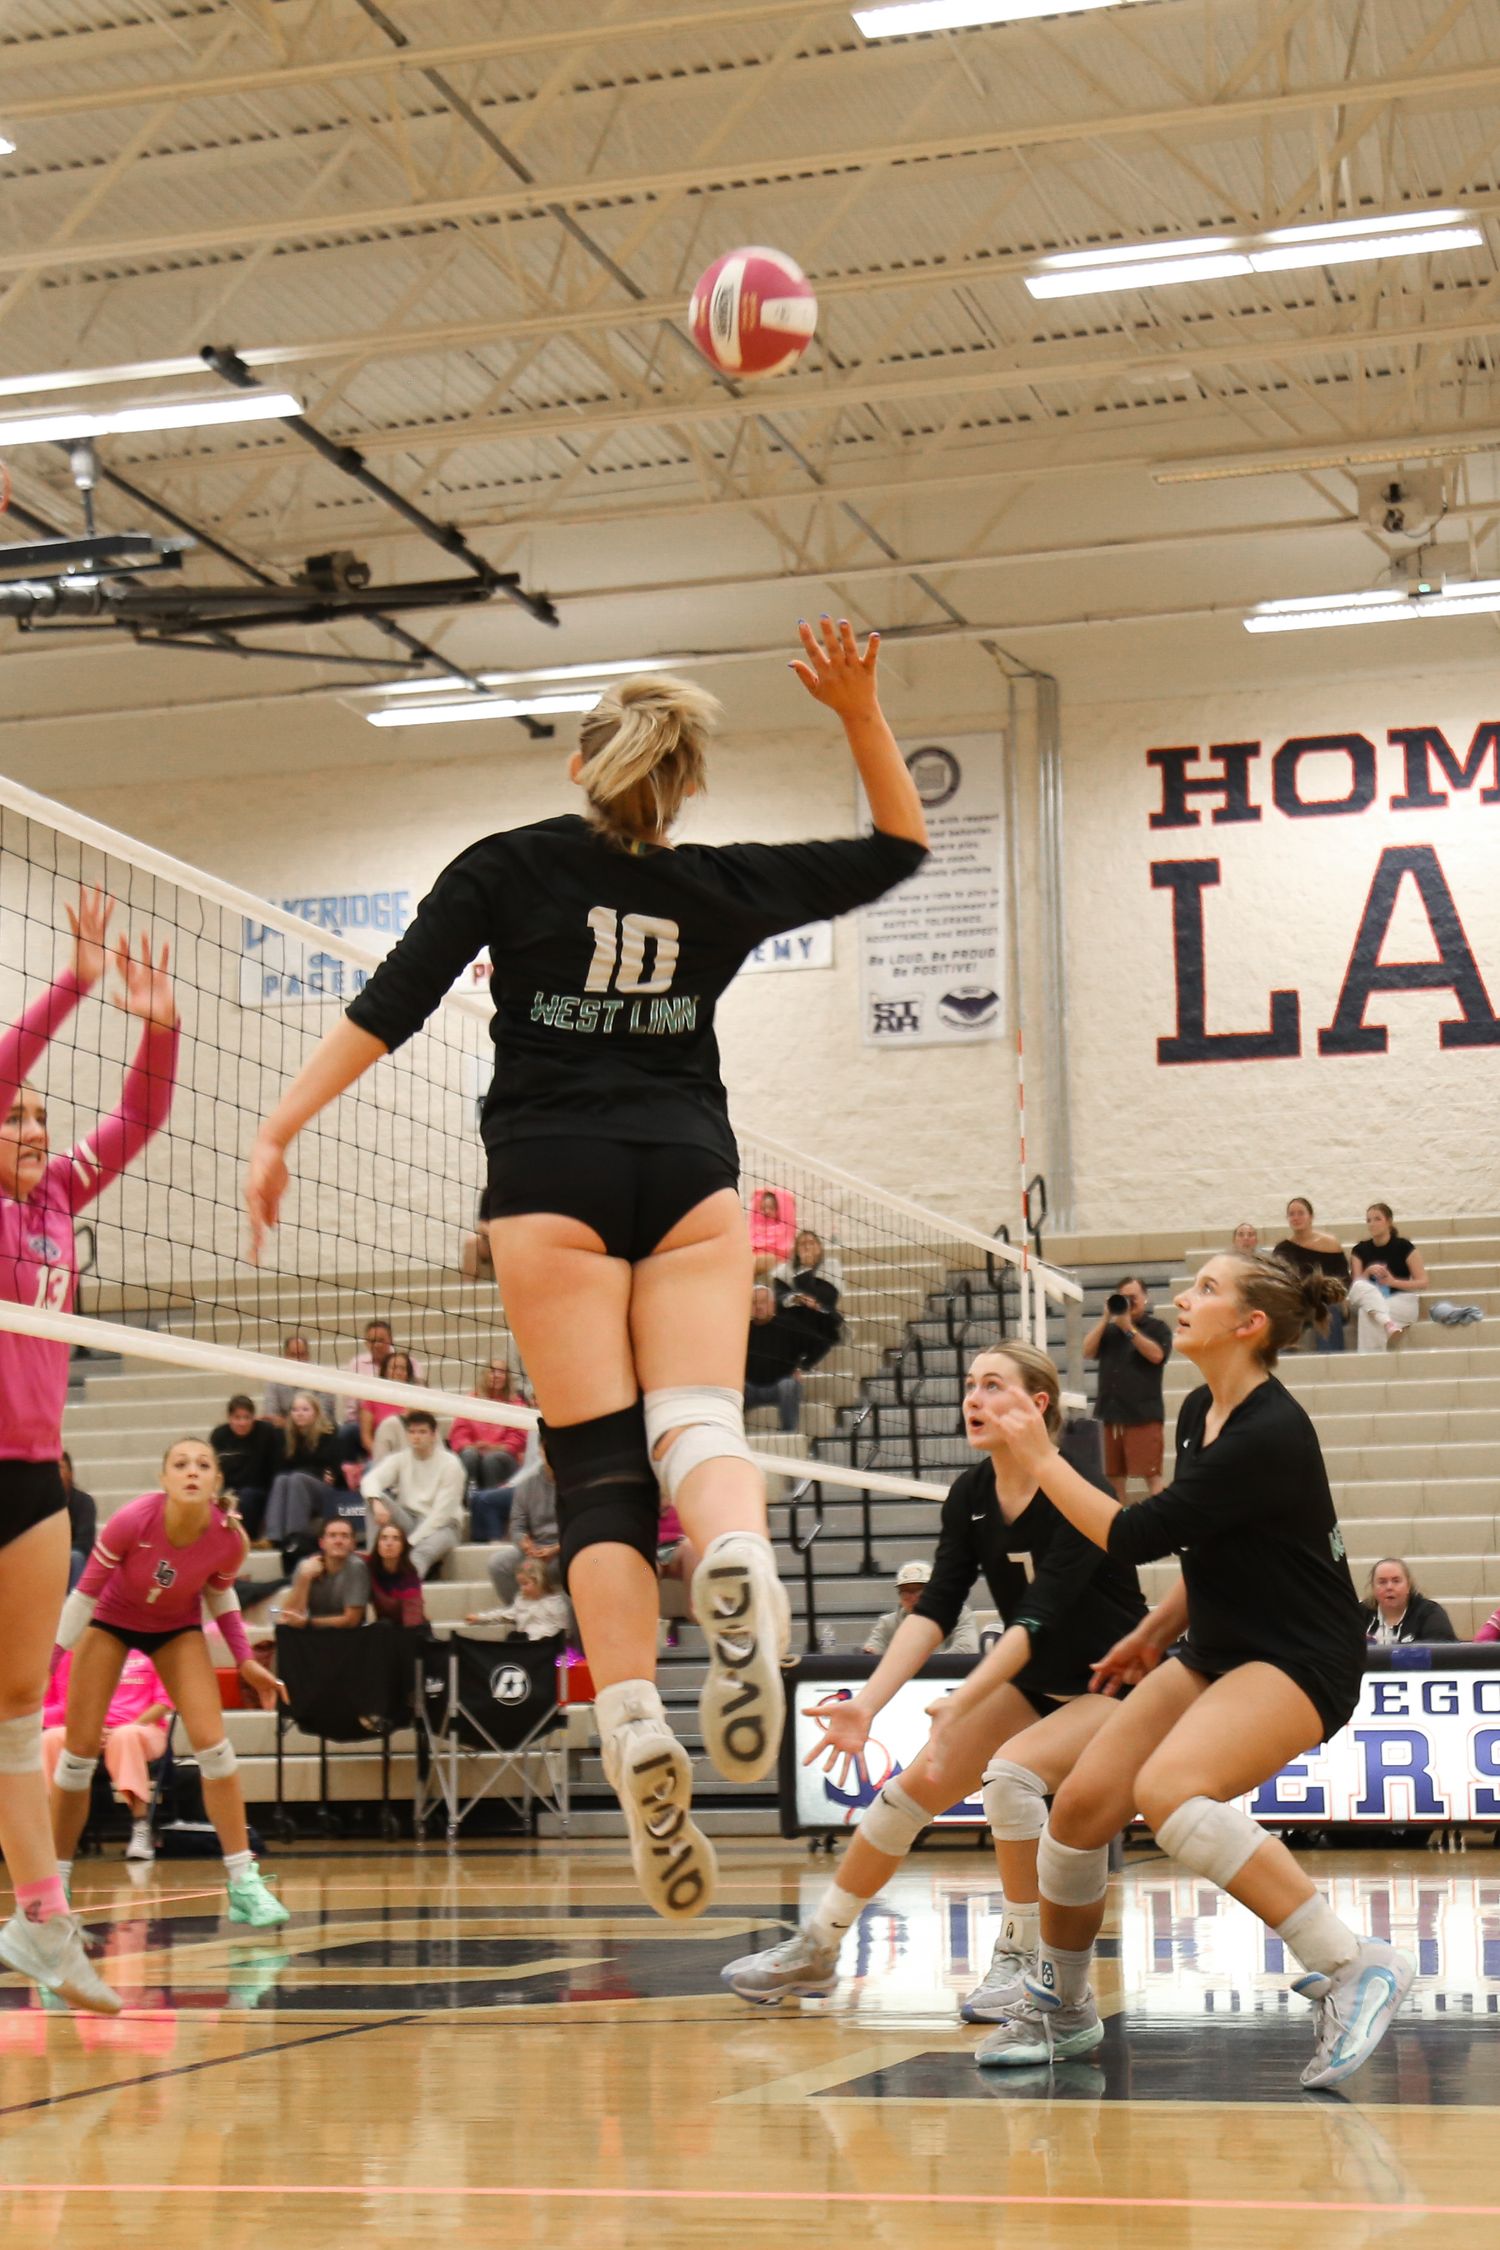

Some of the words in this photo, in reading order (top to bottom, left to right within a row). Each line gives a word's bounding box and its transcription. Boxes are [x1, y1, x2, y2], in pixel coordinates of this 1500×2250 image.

[1146, 721, 1500, 831] HOM
[245, 890, 411, 950] LERIDGE
[583, 905, 680, 994] 10
[1150, 843, 1500, 1067] LA
[531, 991, 624, 1034] WEST
[629, 994, 700, 1035] LINN
